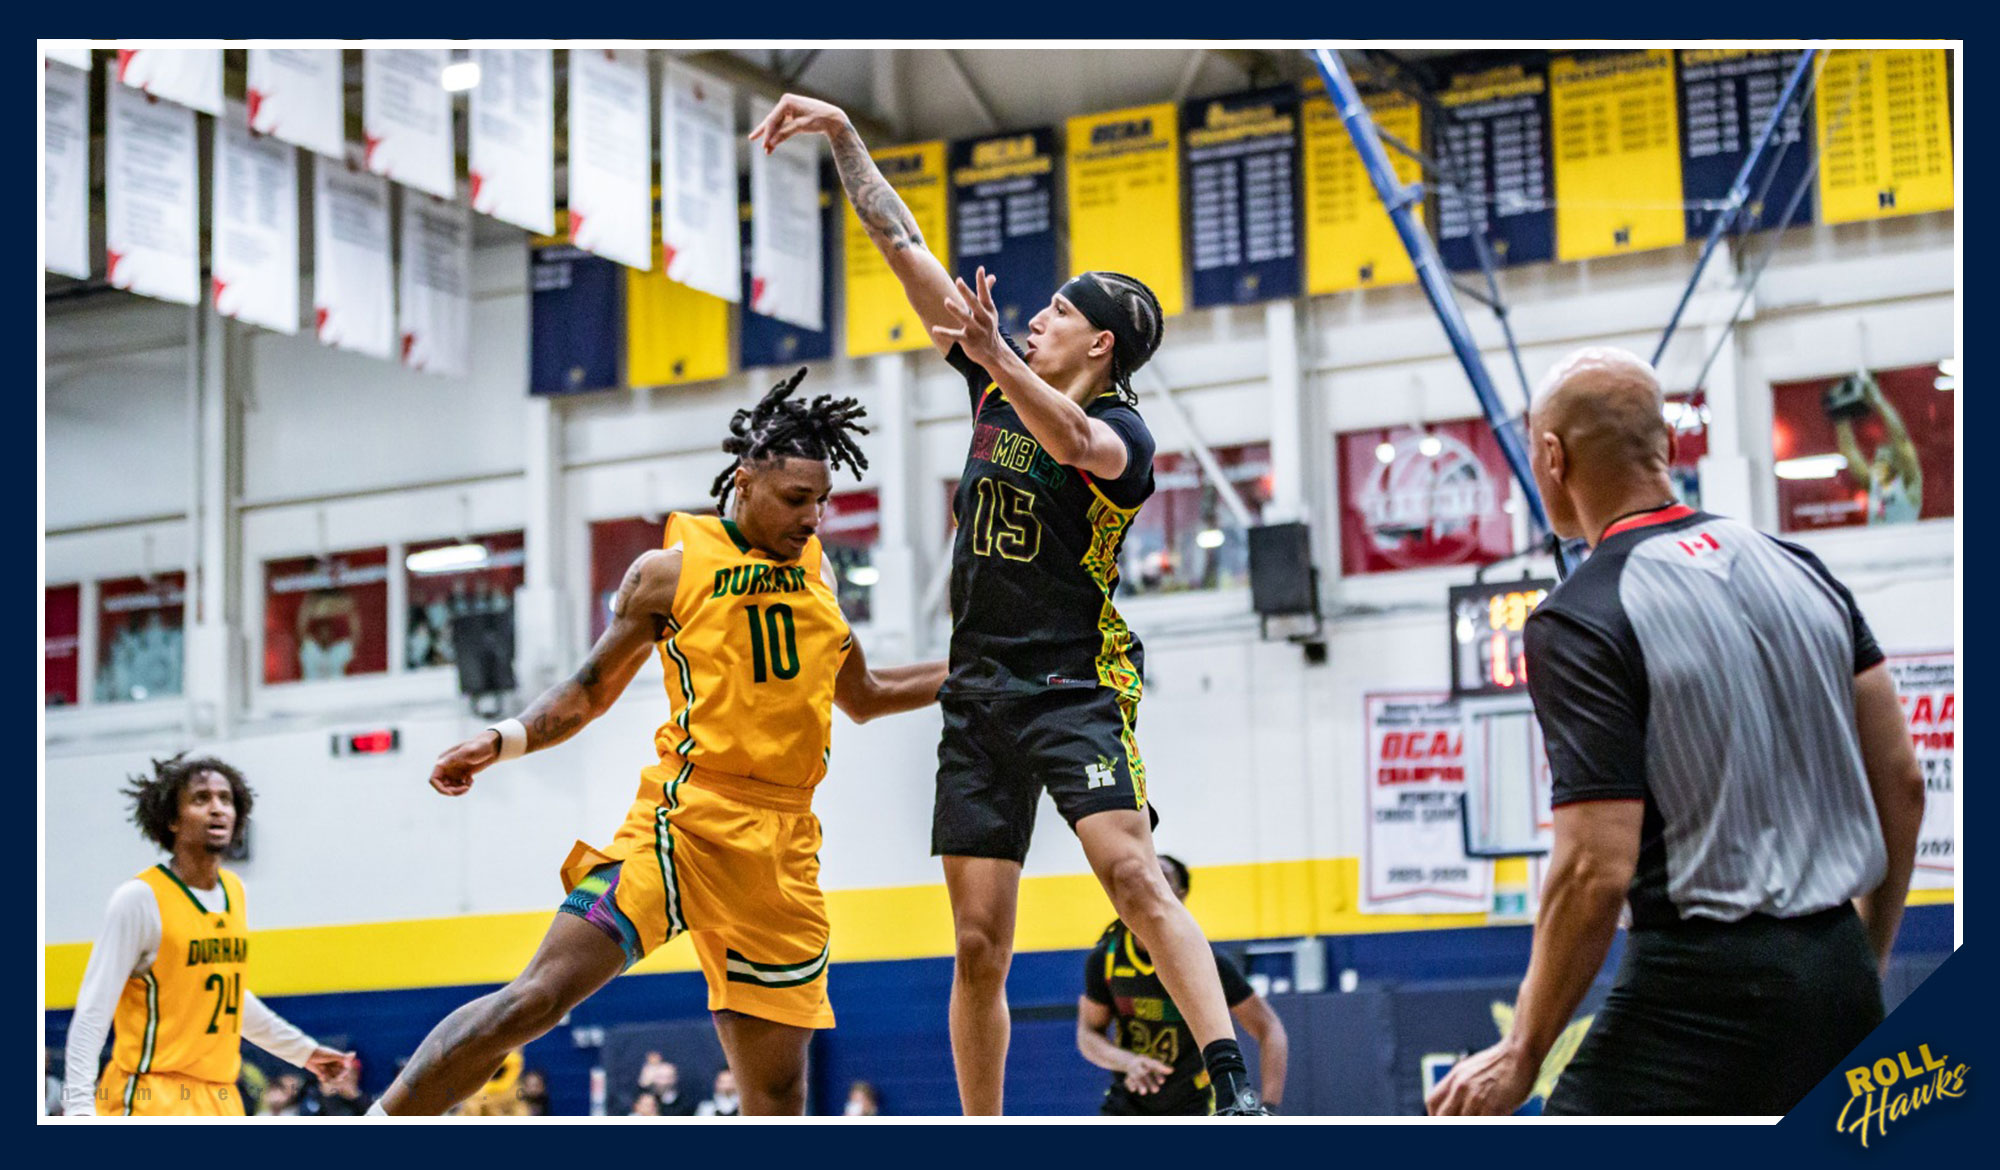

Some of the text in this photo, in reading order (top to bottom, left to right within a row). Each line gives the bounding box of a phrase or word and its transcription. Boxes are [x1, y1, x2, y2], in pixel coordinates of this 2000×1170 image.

[973, 477, 1042, 562] 15
[744, 603, 800, 684] 10
[1377, 766, 1464, 786] CHAMPION
[205, 972, 240, 1035] 24
